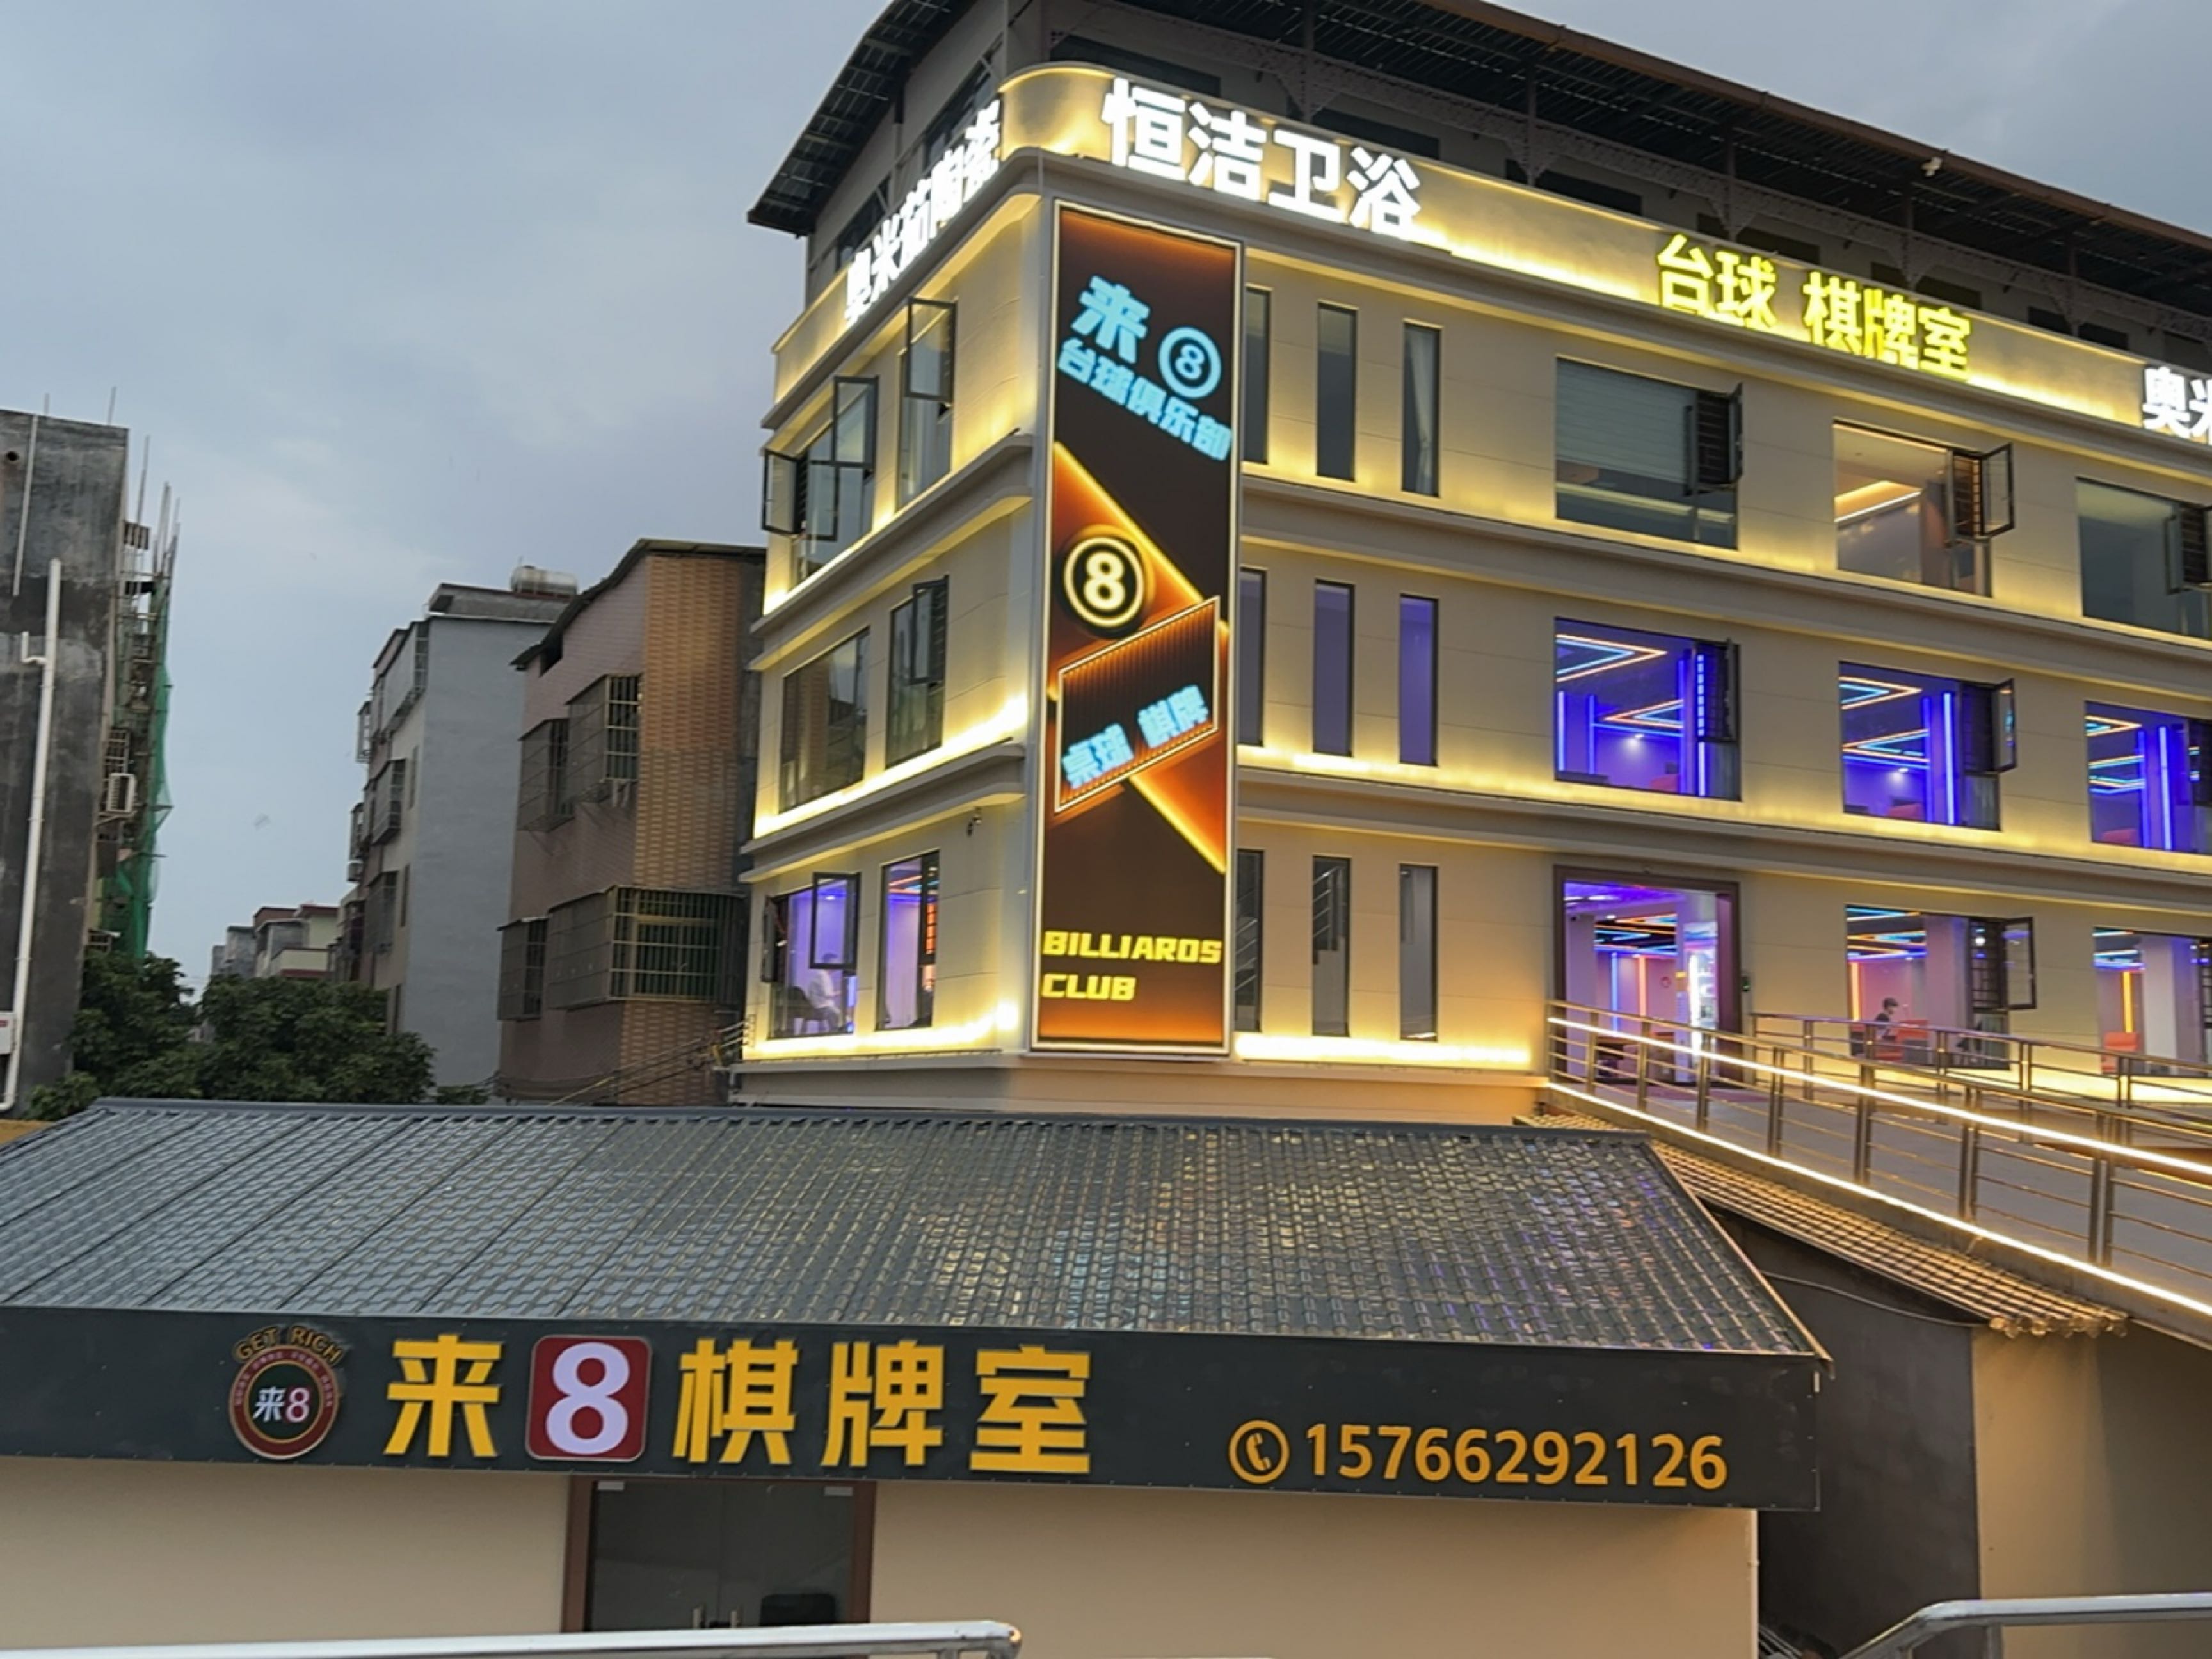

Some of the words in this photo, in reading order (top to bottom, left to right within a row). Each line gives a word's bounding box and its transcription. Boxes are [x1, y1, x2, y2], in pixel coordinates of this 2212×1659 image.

[1101, 78, 1421, 239] 恒洁卫浴
[1658, 234, 1777, 329] 台球
[1802, 271, 1971, 382] 棋牌室
[1058, 337, 1232, 461] 台球俱乐部
[1083, 551, 1125, 611] 8
[1043, 931, 1222, 964] BILLIARDS
[1041, 973, 1136, 1001] CLUB
[234, 1327, 278, 1361] GET
[1306, 1423, 1728, 1489] 15766292126
